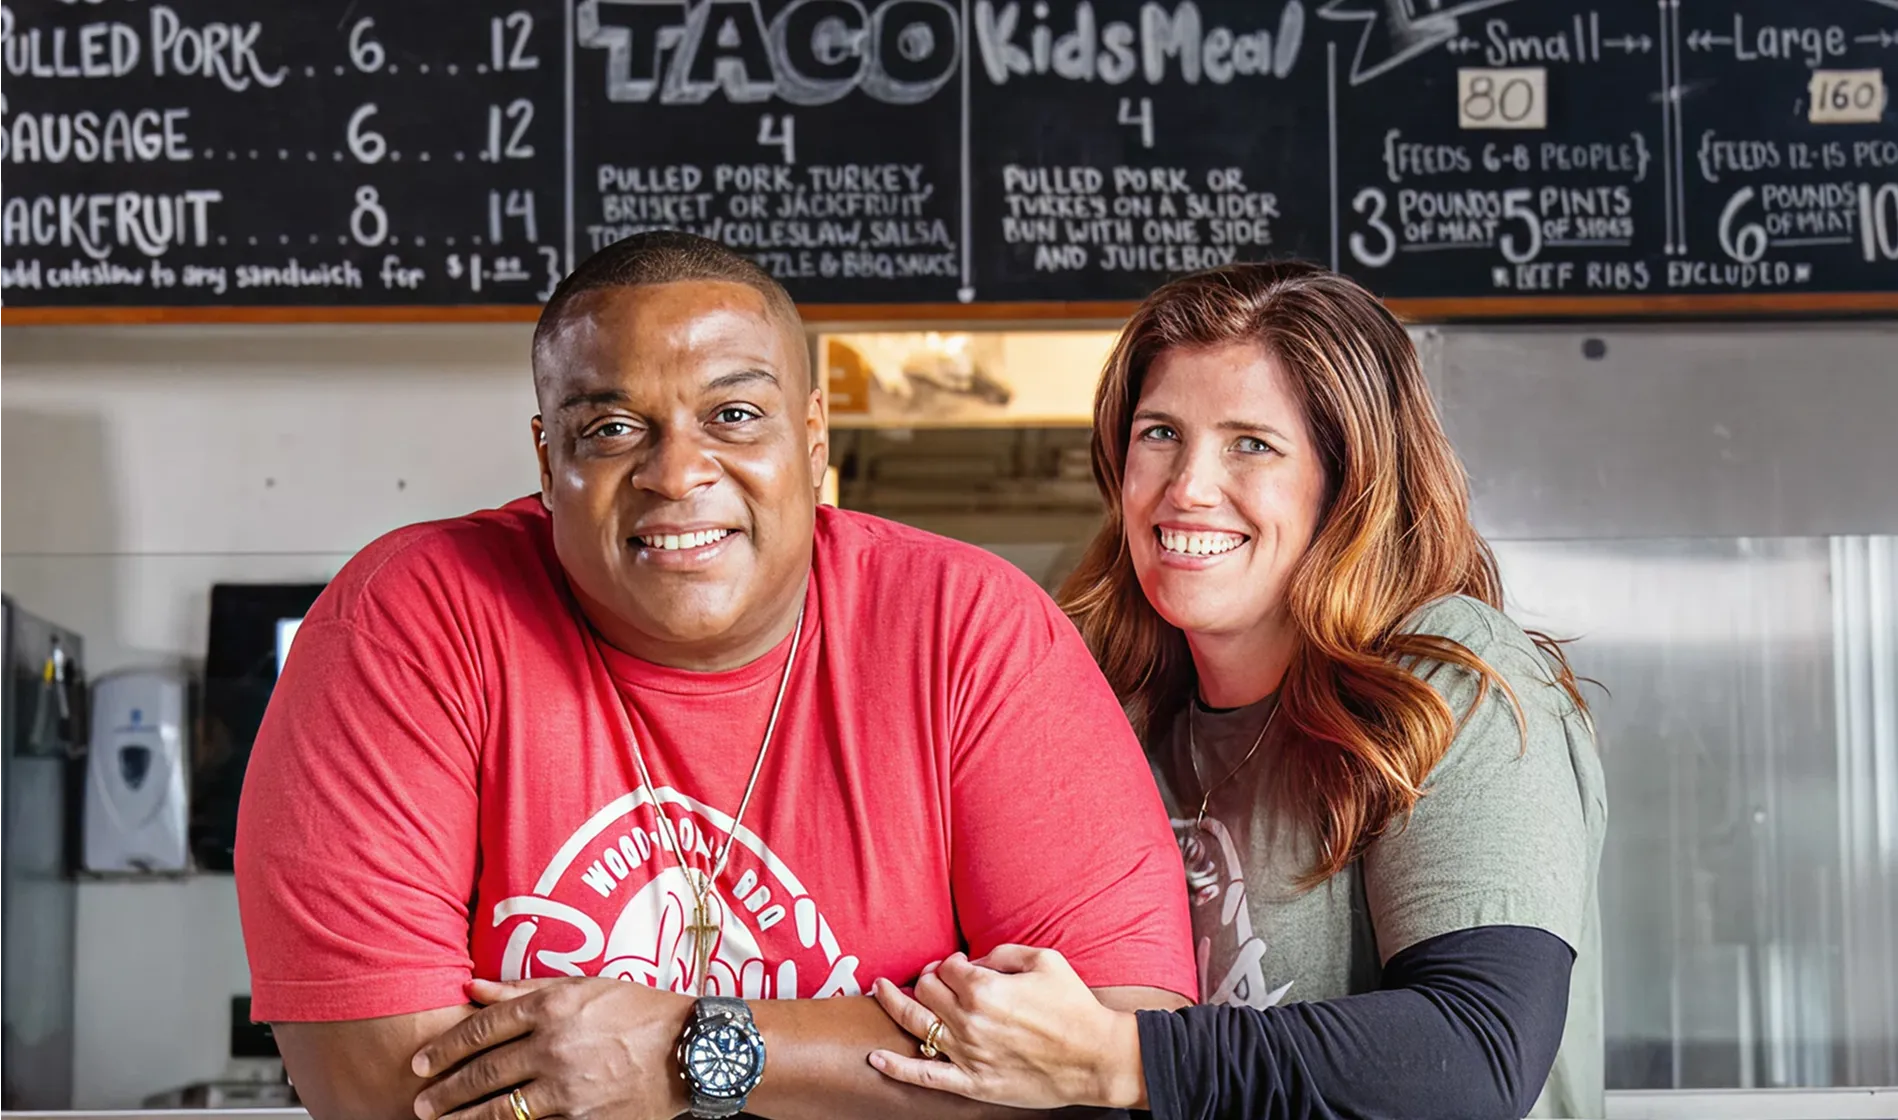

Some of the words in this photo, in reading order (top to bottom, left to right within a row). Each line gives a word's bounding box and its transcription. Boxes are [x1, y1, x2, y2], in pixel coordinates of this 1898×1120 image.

[151, 6, 287, 91] PORK
[349, 17, 386, 73] 6
[492, 12, 539, 71] 12
[577, 0, 961, 105] TACO
[1486, 13, 1599, 66] Small
[1734, 13, 1847, 67] Large
[1463, 76, 1534, 121] 80
[1818, 80, 1875, 111] 160
[347, 104, 387, 164] 6
[490, 99, 535, 162] 12
[1118, 98, 1154, 148] 4
[757, 114, 796, 164] 4
[1483, 143, 1530, 172] 6-8
[1788, 141, 1847, 170] 12-15
[598, 164, 702, 193] PULLED
[1003, 164, 1103, 194] PULLED
[1113, 165, 1191, 193] PORK
[1207, 167, 1248, 193] OR
[603, 194, 713, 224] BRISKET
[729, 194, 768, 219] OR
[777, 194, 926, 218] JACKFRUIT
[1113, 196, 1153, 217] ON
[1159, 194, 1178, 218] A
[1185, 192, 1280, 219] SLIDER
[0, 190, 223, 259] ACKFRUIT
[350, 186, 388, 247] 8
[489, 190, 537, 243] 14
[1002, 216, 1057, 243] BUN
[1064, 219, 1134, 246] WITH
[1142, 219, 1200, 245] ONE
[1209, 218, 1272, 246] SIDE
[1349, 187, 1396, 267] 3
[1398, 189, 1500, 226] POUNDS
[1500, 189, 1542, 264] 5
[1540, 186, 1632, 217] PINTS
[1404, 220, 1434, 242] OF
[1543, 219, 1569, 238] OF
[1718, 186, 1768, 263] 6
[1762, 183, 1857, 211] POUNDS
[1766, 212, 1794, 236] OF
[151, 259, 177, 288] to
[235, 258, 362, 288] sandwich
[379, 254, 425, 290] for
[1034, 244, 1088, 273] AND
[1586, 261, 1650, 290] RIBS
